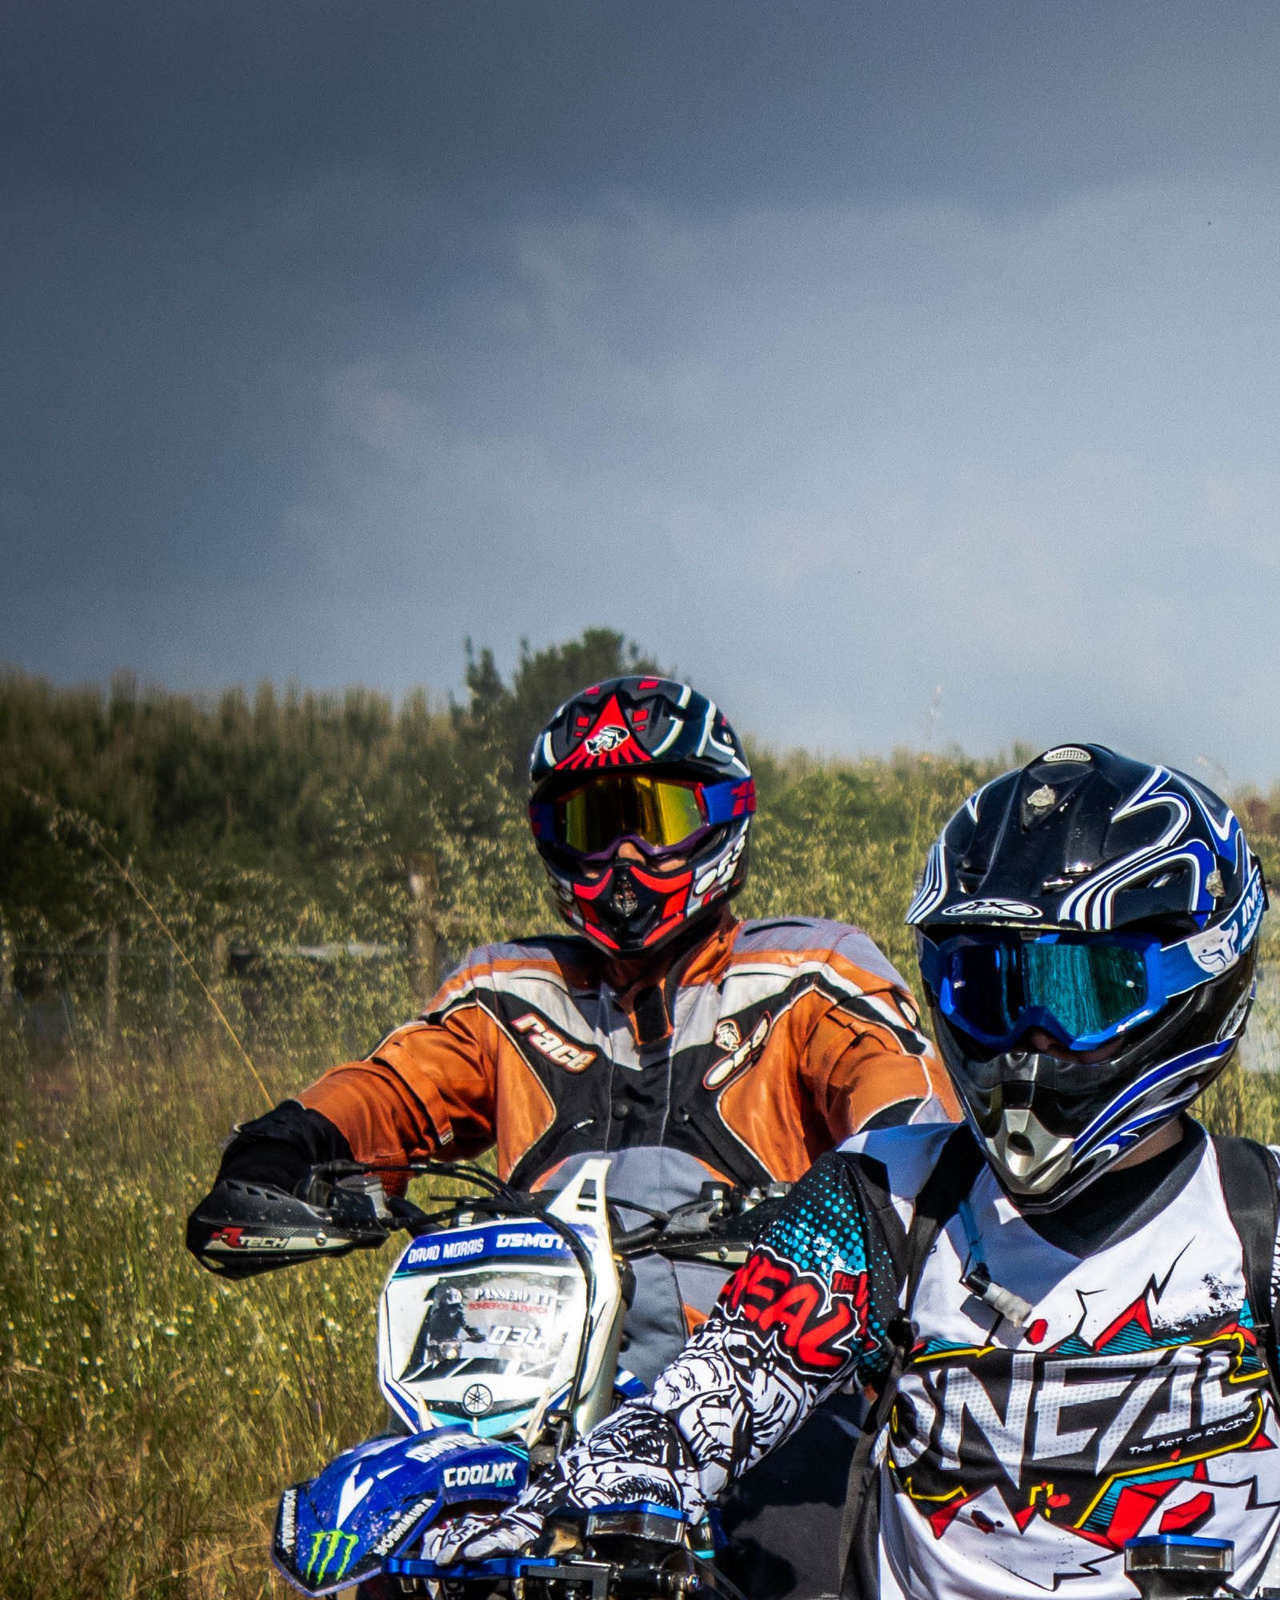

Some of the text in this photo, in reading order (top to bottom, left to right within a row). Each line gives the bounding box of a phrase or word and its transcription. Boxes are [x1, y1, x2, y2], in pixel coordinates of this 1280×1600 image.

[512, 1013, 597, 1073] race
[408, 1246, 440, 1264] DAVID
[443, 1238, 485, 1259] MORAIS
[487, 1325, 544, 1347] 034
[1129, 1411, 1255, 1455] THE ART OF RACING
[443, 1462, 518, 1488] COOLMX
